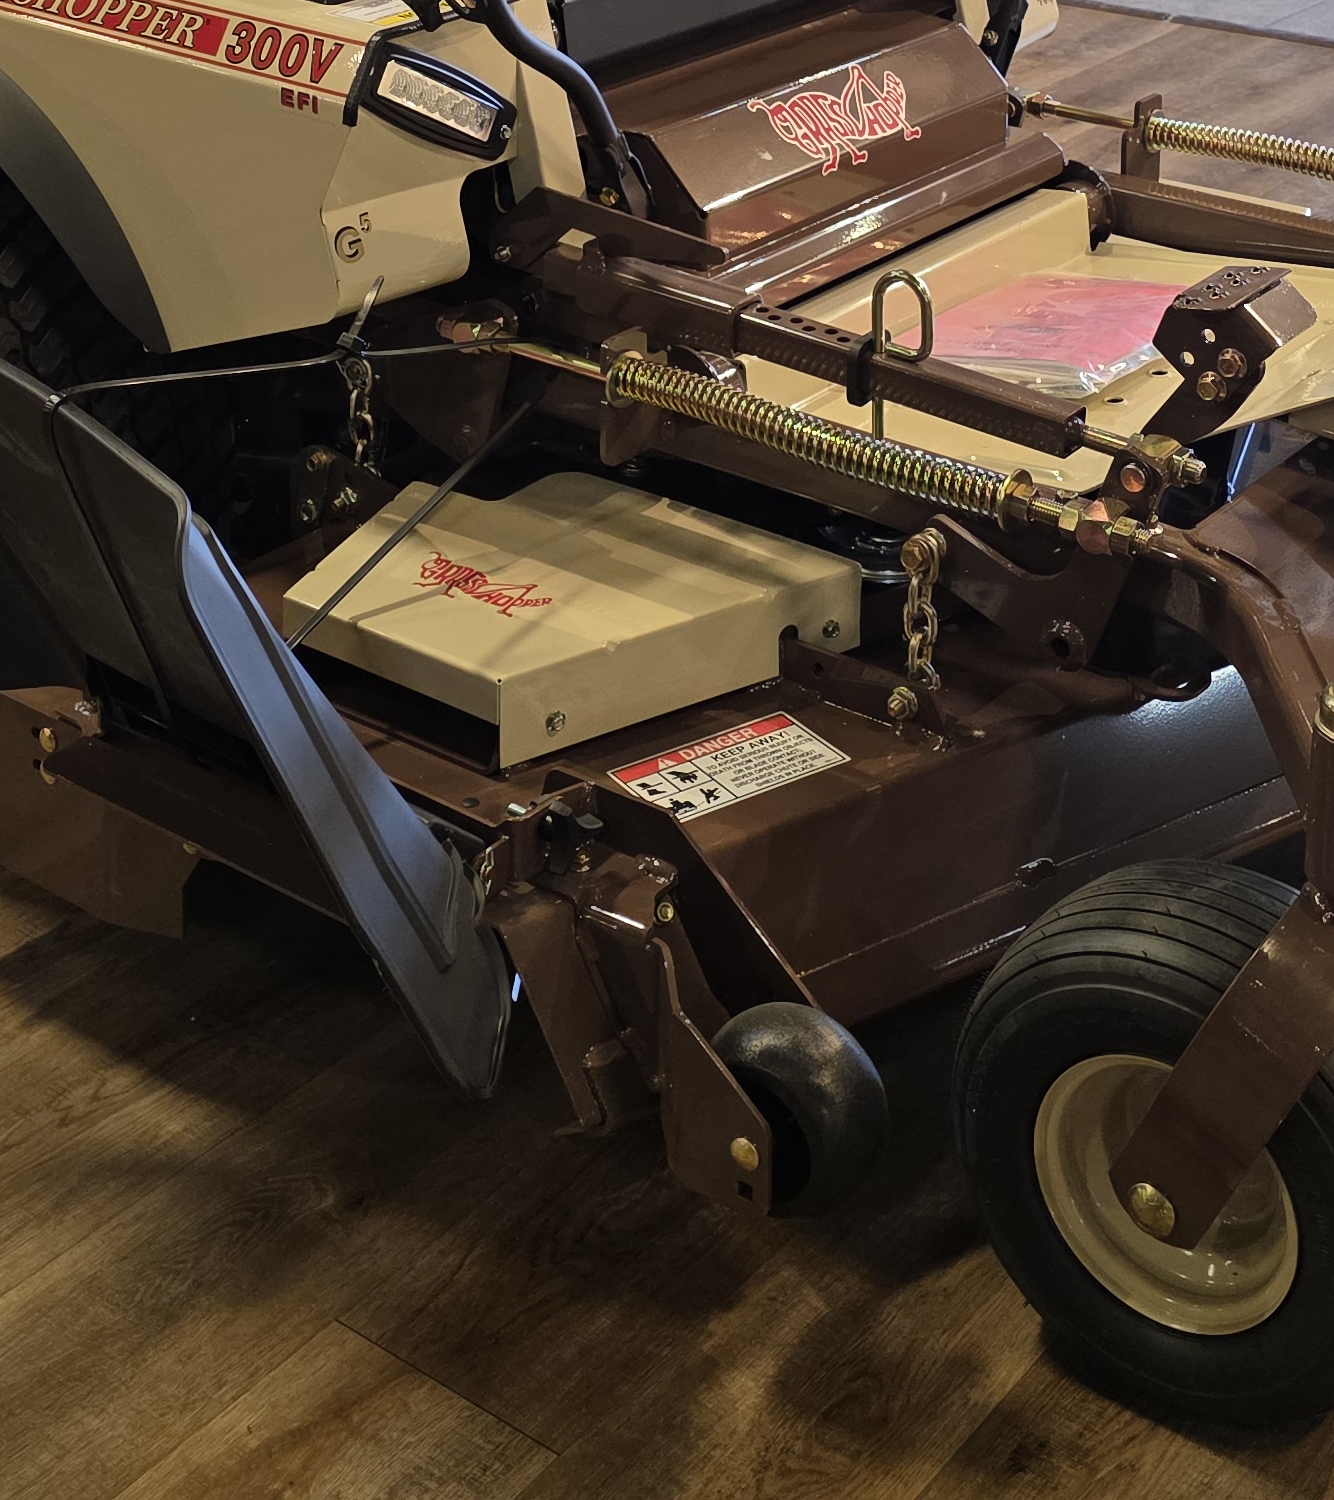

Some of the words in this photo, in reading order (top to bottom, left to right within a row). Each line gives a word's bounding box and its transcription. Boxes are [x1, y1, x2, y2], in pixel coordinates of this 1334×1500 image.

[224, 20, 344, 84] 300V
[280, 87, 319, 115] EFI
[679, 727, 758, 761] DANGER
[710, 745, 744, 762] KEEP
[748, 730, 790, 750] AWAY!
[717, 757, 740, 767] AVOID
[730, 771, 755, 782] NEVER
[754, 760, 787, 774] OPERATE
[787, 749, 817, 762] WITHOUT
[733, 758, 754, 769] FROM
[734, 771, 774, 788] DISCHARGE
